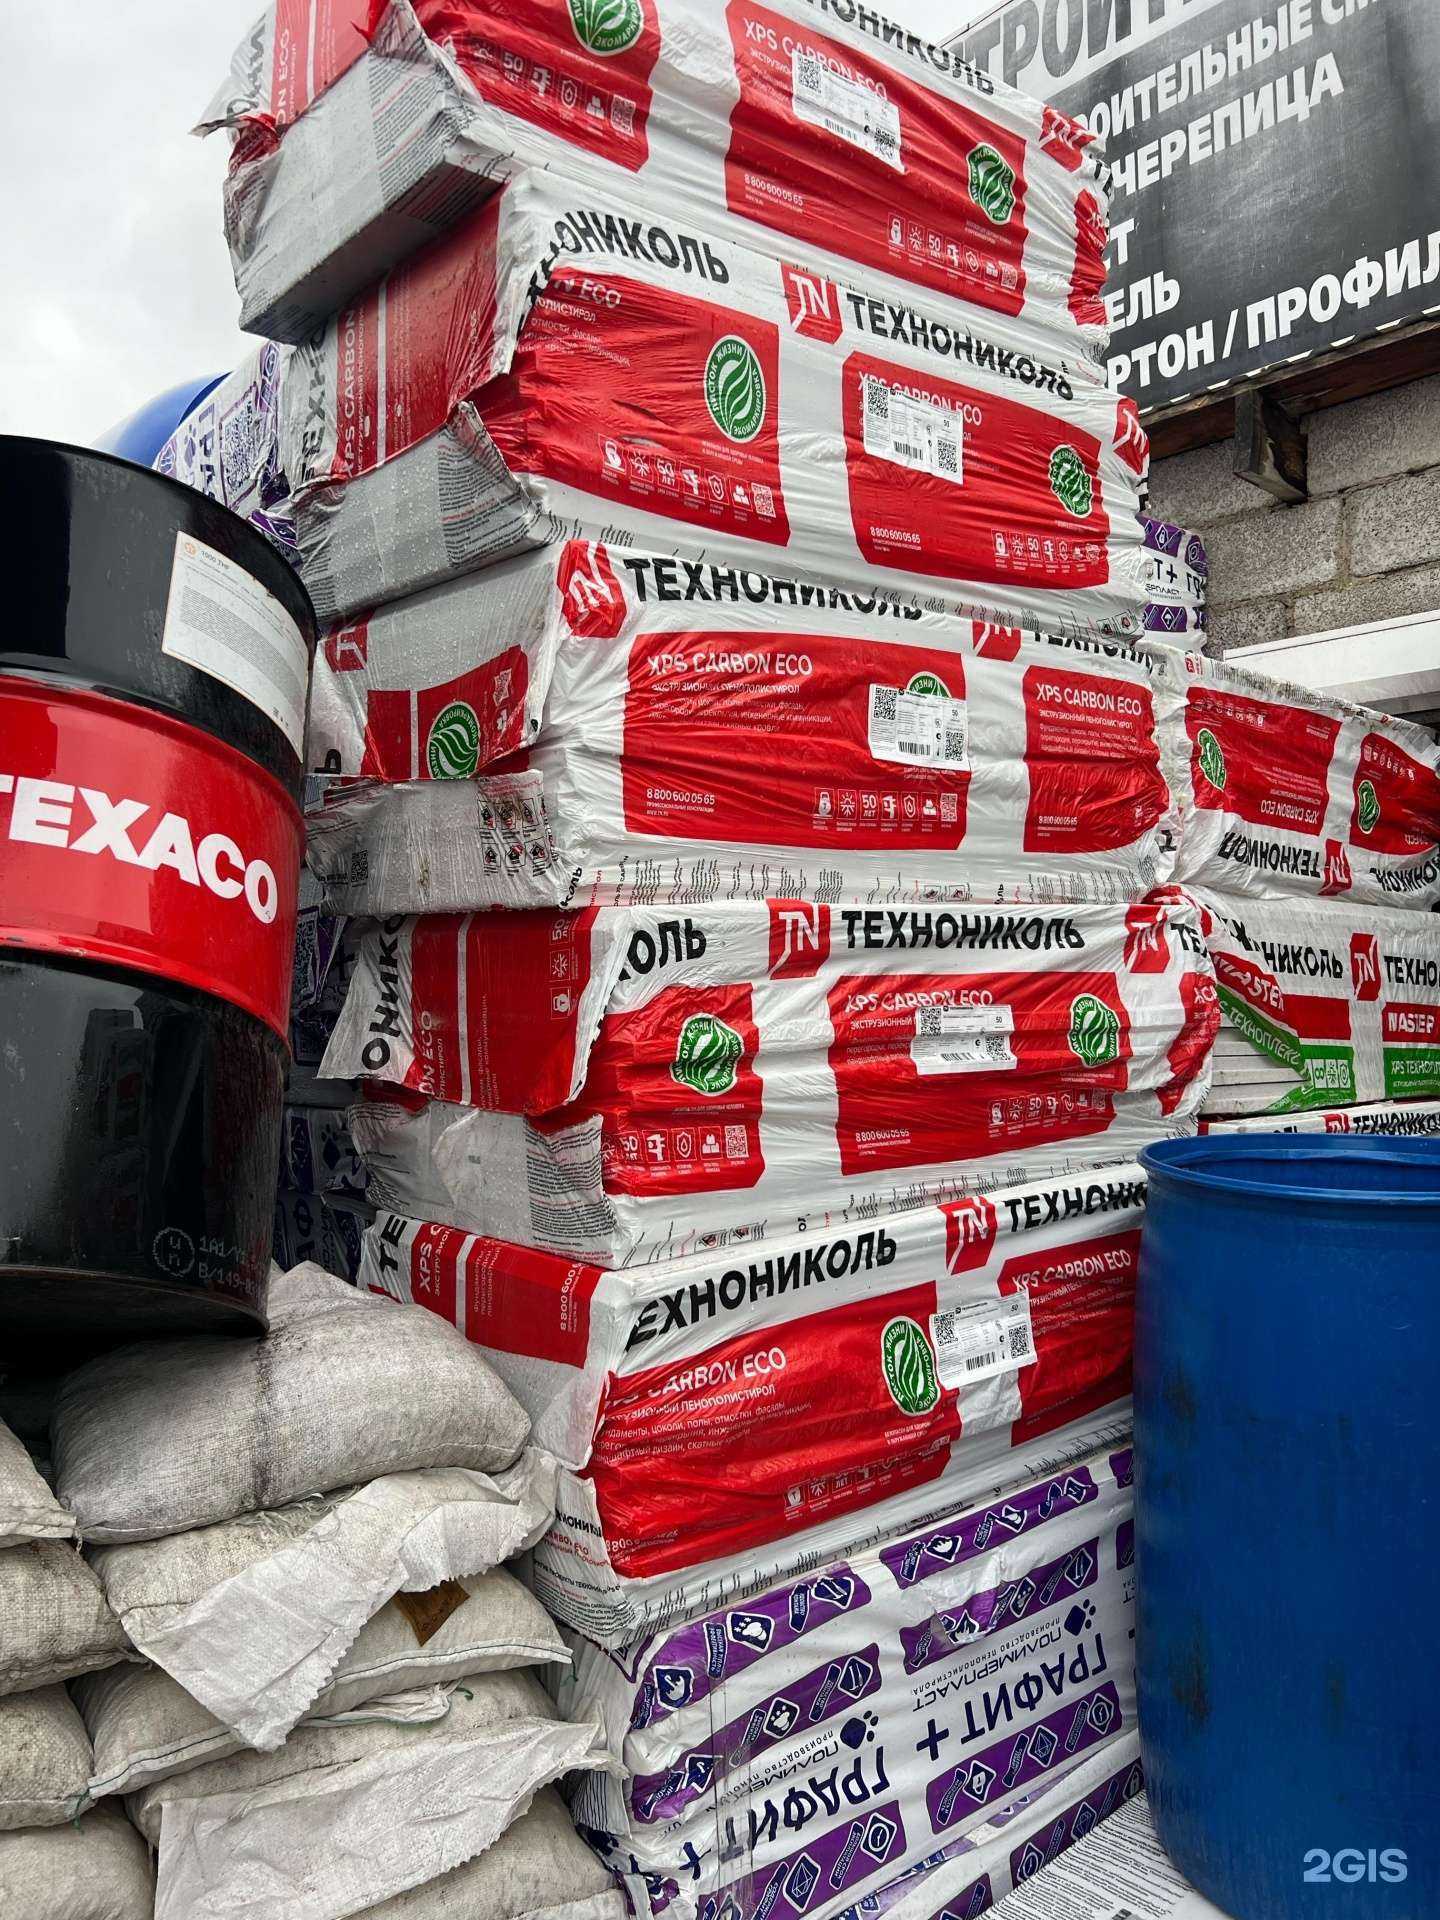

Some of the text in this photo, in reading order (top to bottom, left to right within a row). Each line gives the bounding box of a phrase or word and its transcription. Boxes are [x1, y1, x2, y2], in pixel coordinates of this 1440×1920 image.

[743, 17, 779, 51] XPS
[503, 51, 524, 74] 50
[1111, 52, 1345, 198] ЧЕРЕПИЦА
[928, 233, 941, 251] 50
[847, 292, 1074, 401] ТЕХНОНИКОЛЬ
[1107, 322, 1214, 391] РТОН
[344, 311, 356, 419] CARBON
[655, 456, 675, 475] 50
[1027, 536, 1039, 550] 50
[648, 652, 813, 676] XPS CARBON ECO
[1036, 683, 1142, 716] XPS CARBON ECO
[862, 794, 877, 810] 50
[1261, 799, 1276, 815] ECO
[1276, 802, 1305, 821] CARBON
[552, 918, 566, 941] 50
[841, 910, 1086, 950] ТЕХНОНИКОЛЬ
[1170, 922, 1208, 958] ТЕ
[1384, 956, 1440, 988] ТЕХНО
[881, 990, 956, 1011] CARBON
[960, 990, 993, 1008] ECO
[421, 1010, 434, 1060] ECO
[850, 1015, 912, 1031] ЭКСТРУЗИОННЫЙ
[1229, 1006, 1300, 1065] ТЕХНОПЛЕКС
[1028, 1097, 1042, 1111] 50
[622, 1133, 637, 1153] 50
[419, 1242, 433, 1294] XPS
[1107, 1249, 1132, 1271] ECO
[626, 1229, 897, 1352] ЕХНОНИКОЛЬ
[647, 1347, 787, 1397] ARBON ECO
[681, 1383, 777, 1413] ПЕНОПОЛИСТИРОЛ
[687, 1418, 714, 1431] полы,
[913, 1616, 1061, 1696] ПРОИЗВОДСТВО ПЕНОПОЛИСТИРОЛА
[913, 1628, 1062, 1712] ПОЛИМЕРПЛАСТ
[961, 1633, 1107, 1745] ГРАФИТ
[765, 1730, 834, 1774] ПРОИЗВОДСТВО
[721, 1746, 890, 1863] ГРАФИТ
